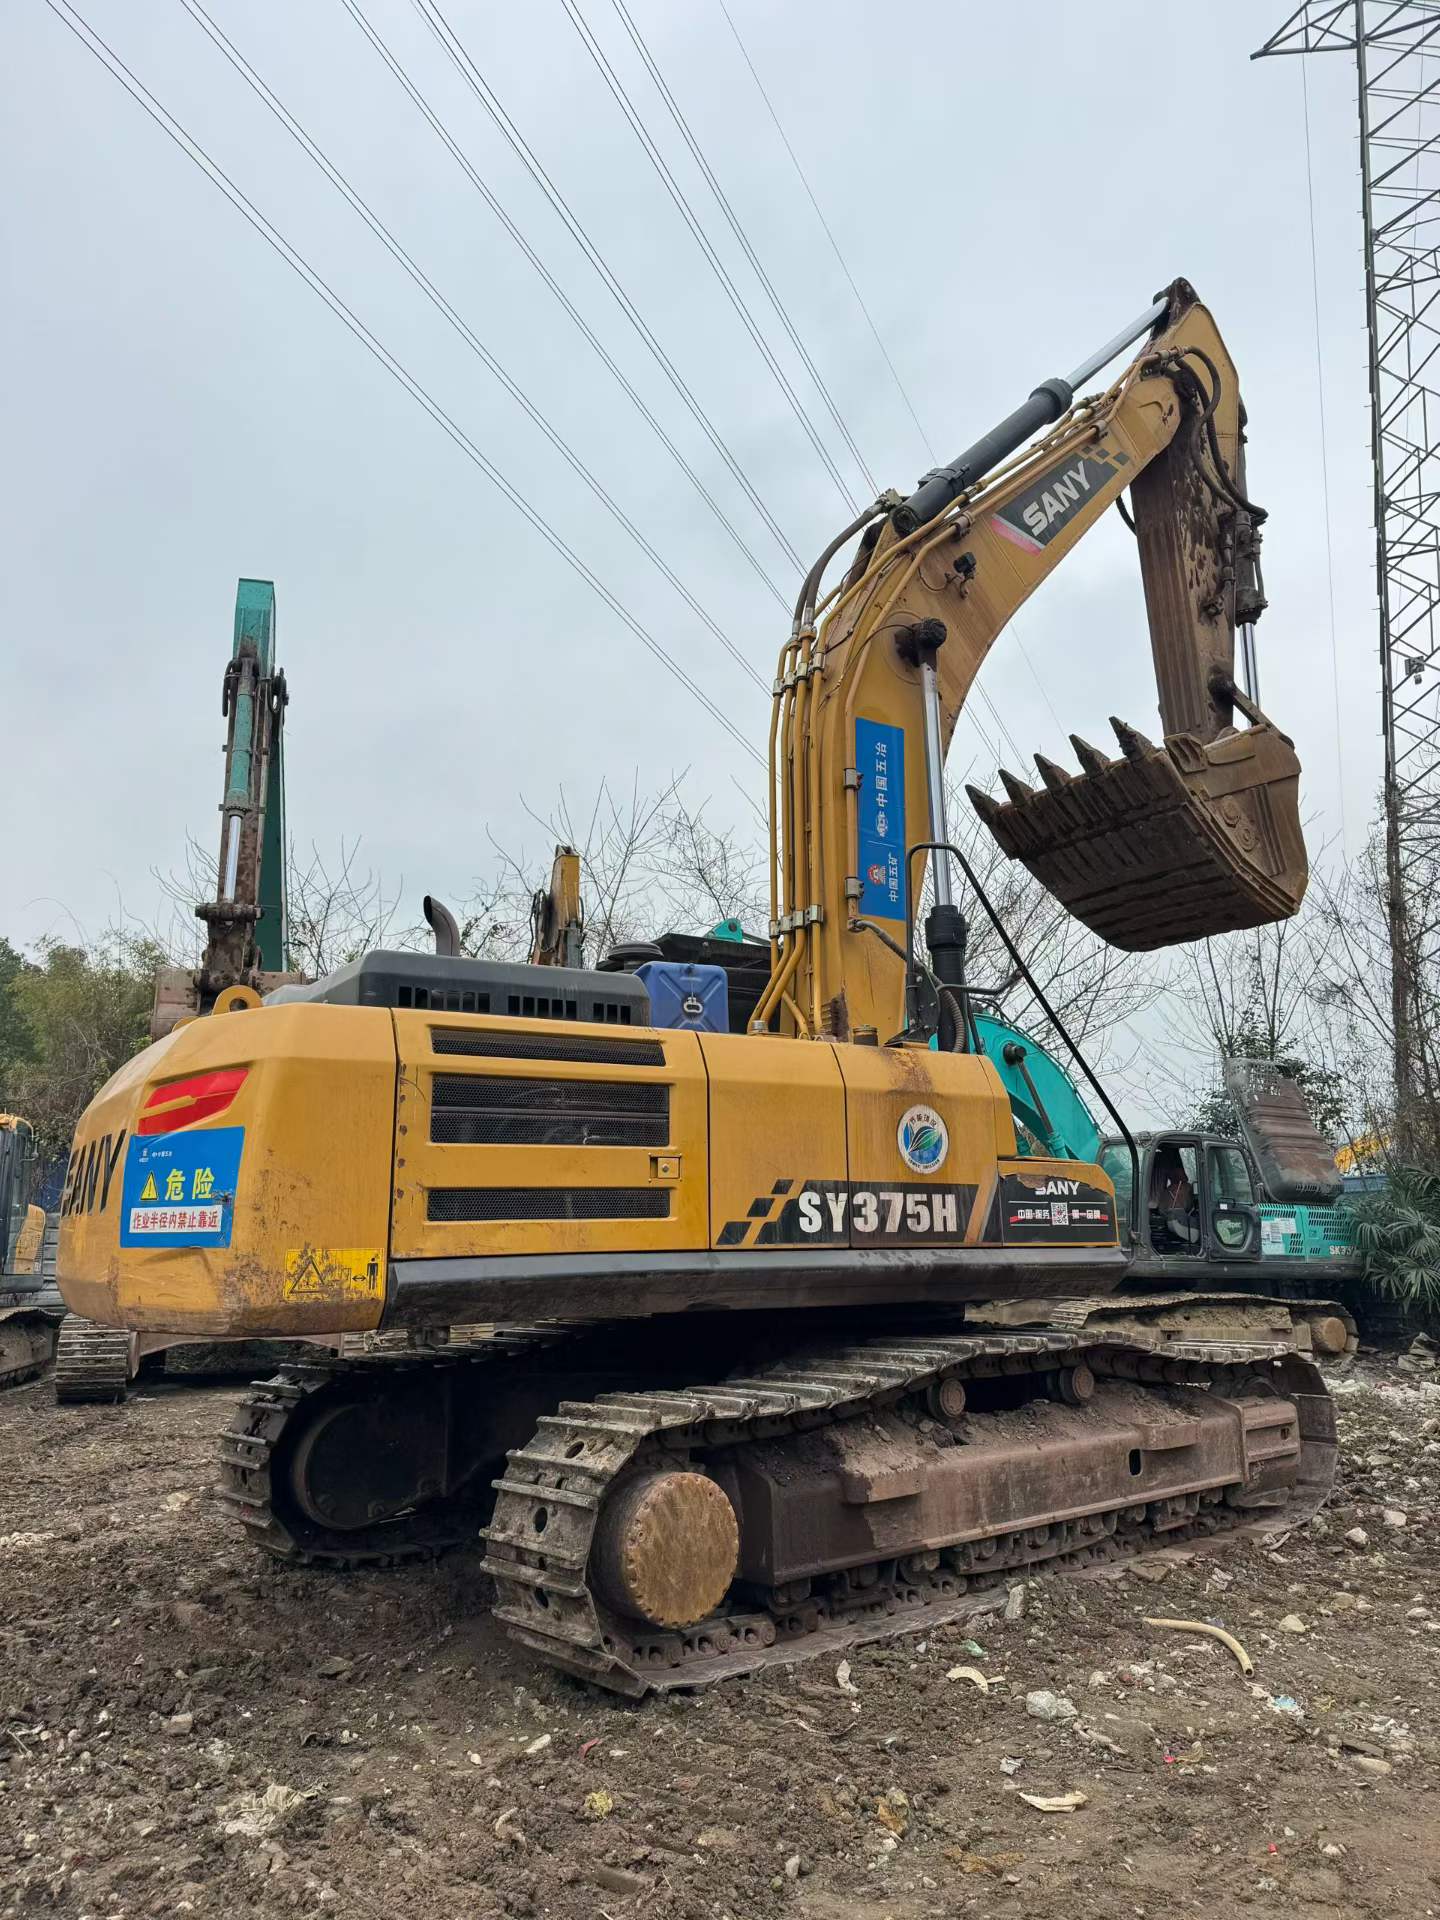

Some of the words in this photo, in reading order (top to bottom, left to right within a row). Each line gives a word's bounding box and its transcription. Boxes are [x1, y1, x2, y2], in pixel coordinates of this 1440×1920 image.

[1022, 460, 1091, 537] SANY
[875, 742, 888, 808] 中国五冶
[887, 851, 899, 902] 中国五矿
[61, 1128, 126, 1217] SANY
[165, 1167, 216, 1201] 危险
[133, 1210, 219, 1231] 作业半径内禁止靠近
[798, 1191, 958, 1234] SY375H
